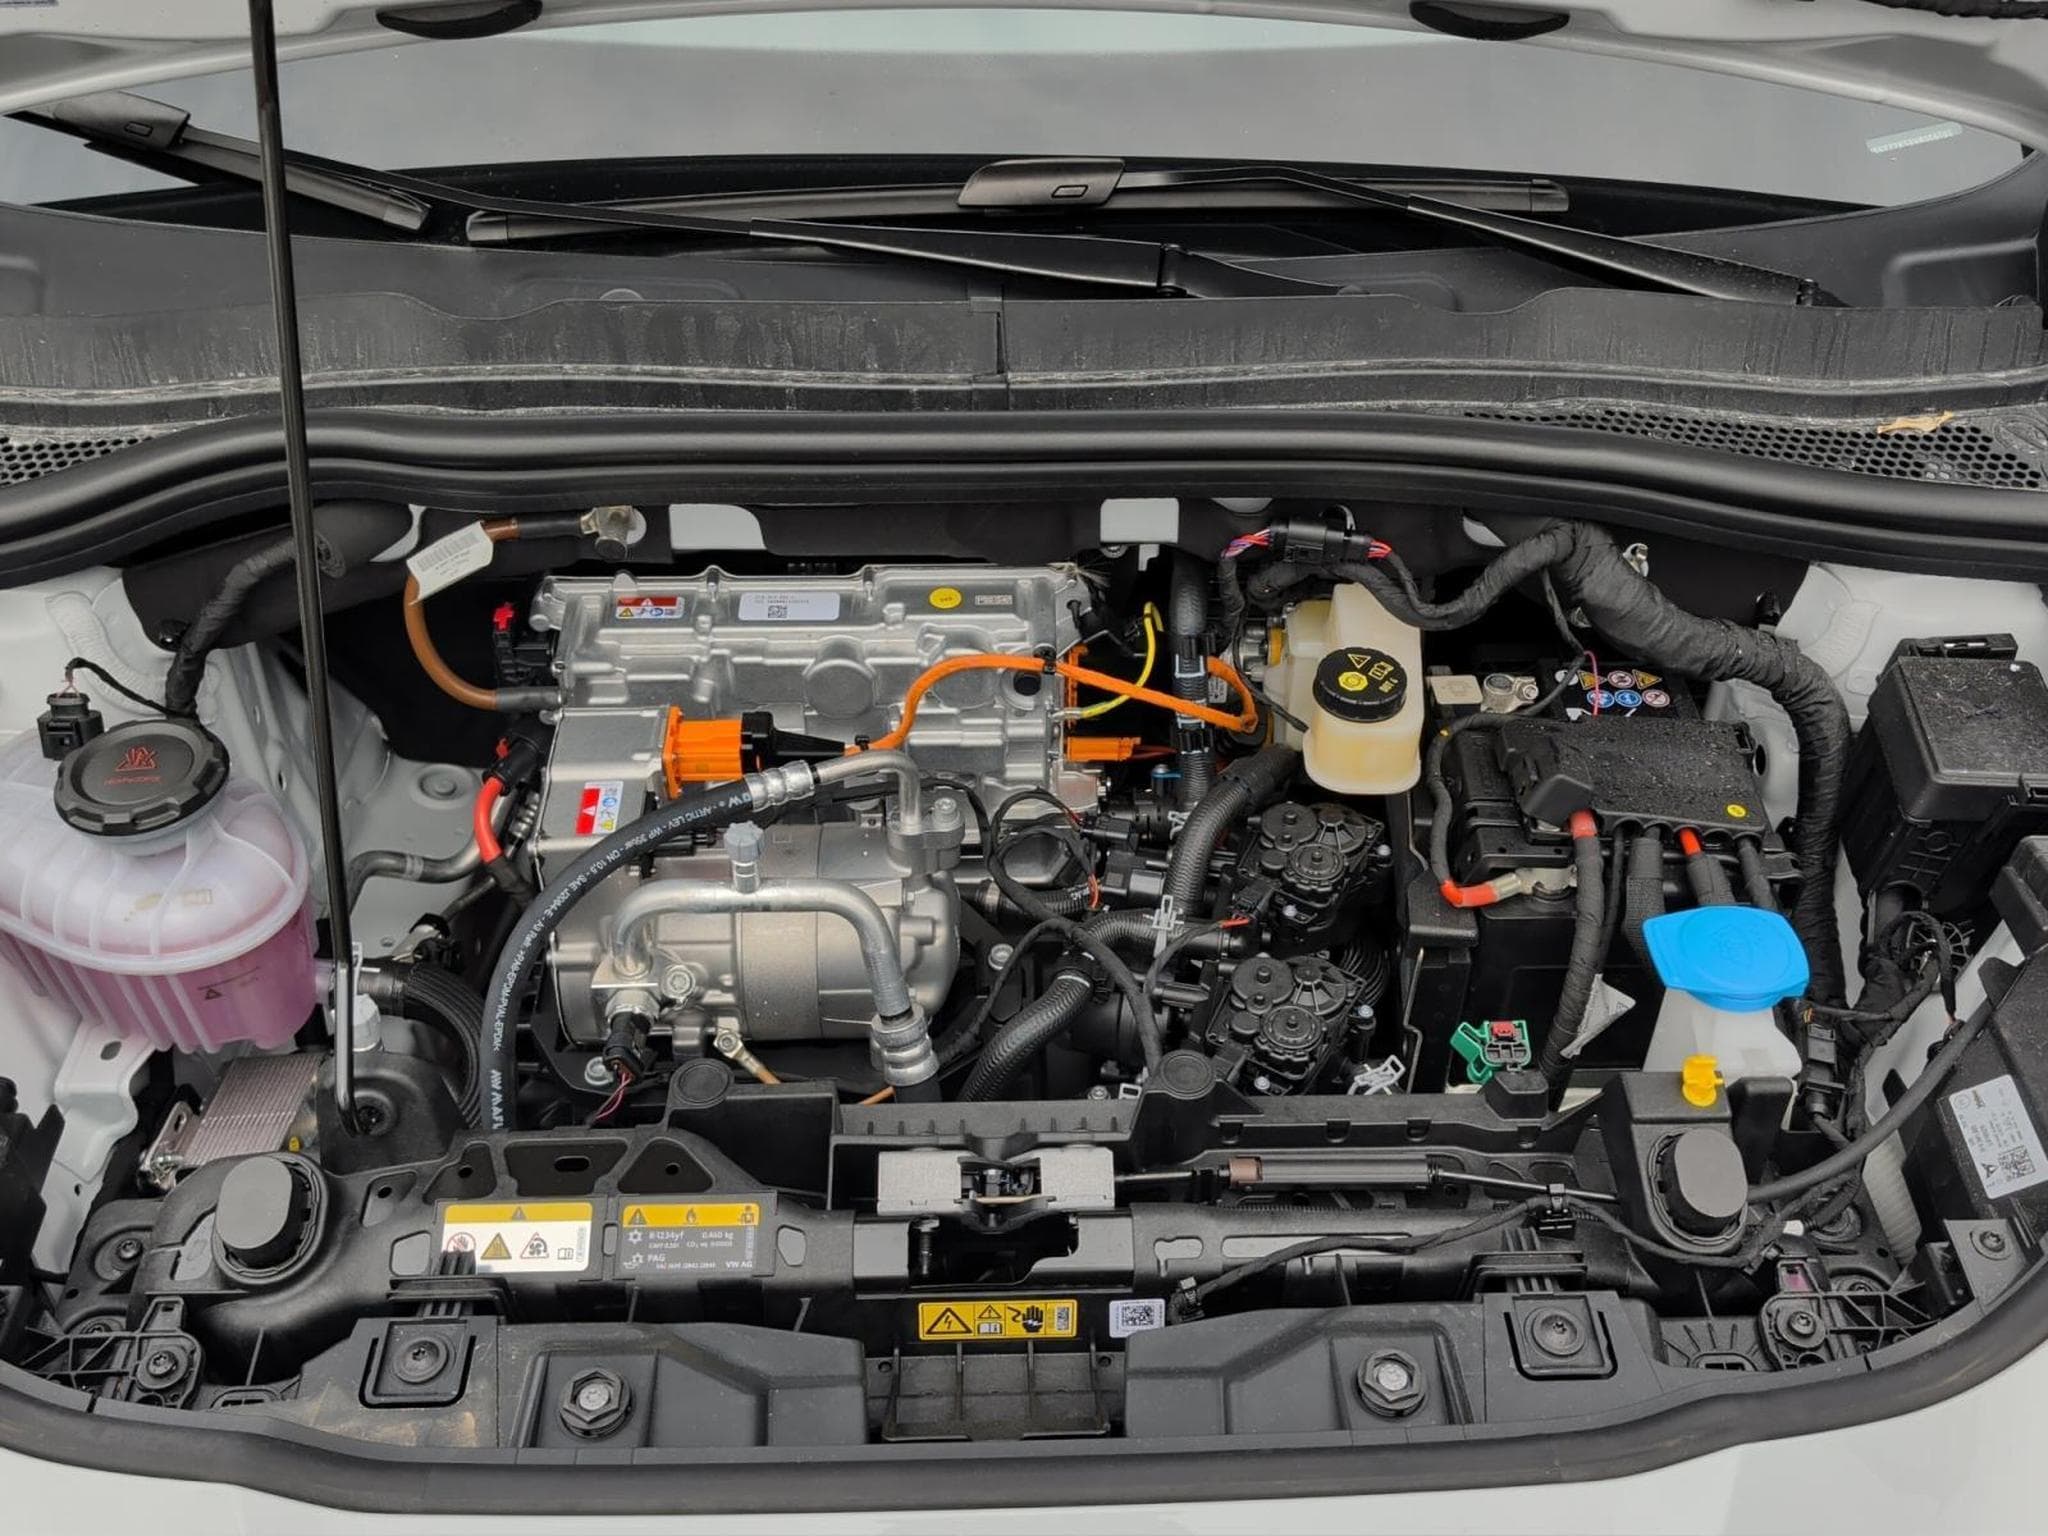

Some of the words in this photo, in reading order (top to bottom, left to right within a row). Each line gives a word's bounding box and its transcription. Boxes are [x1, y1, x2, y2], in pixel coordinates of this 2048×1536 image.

[668, 815, 686, 830] LEV
[568, 874, 588, 891] SAE
[740, 1260, 753, 1269] AG
